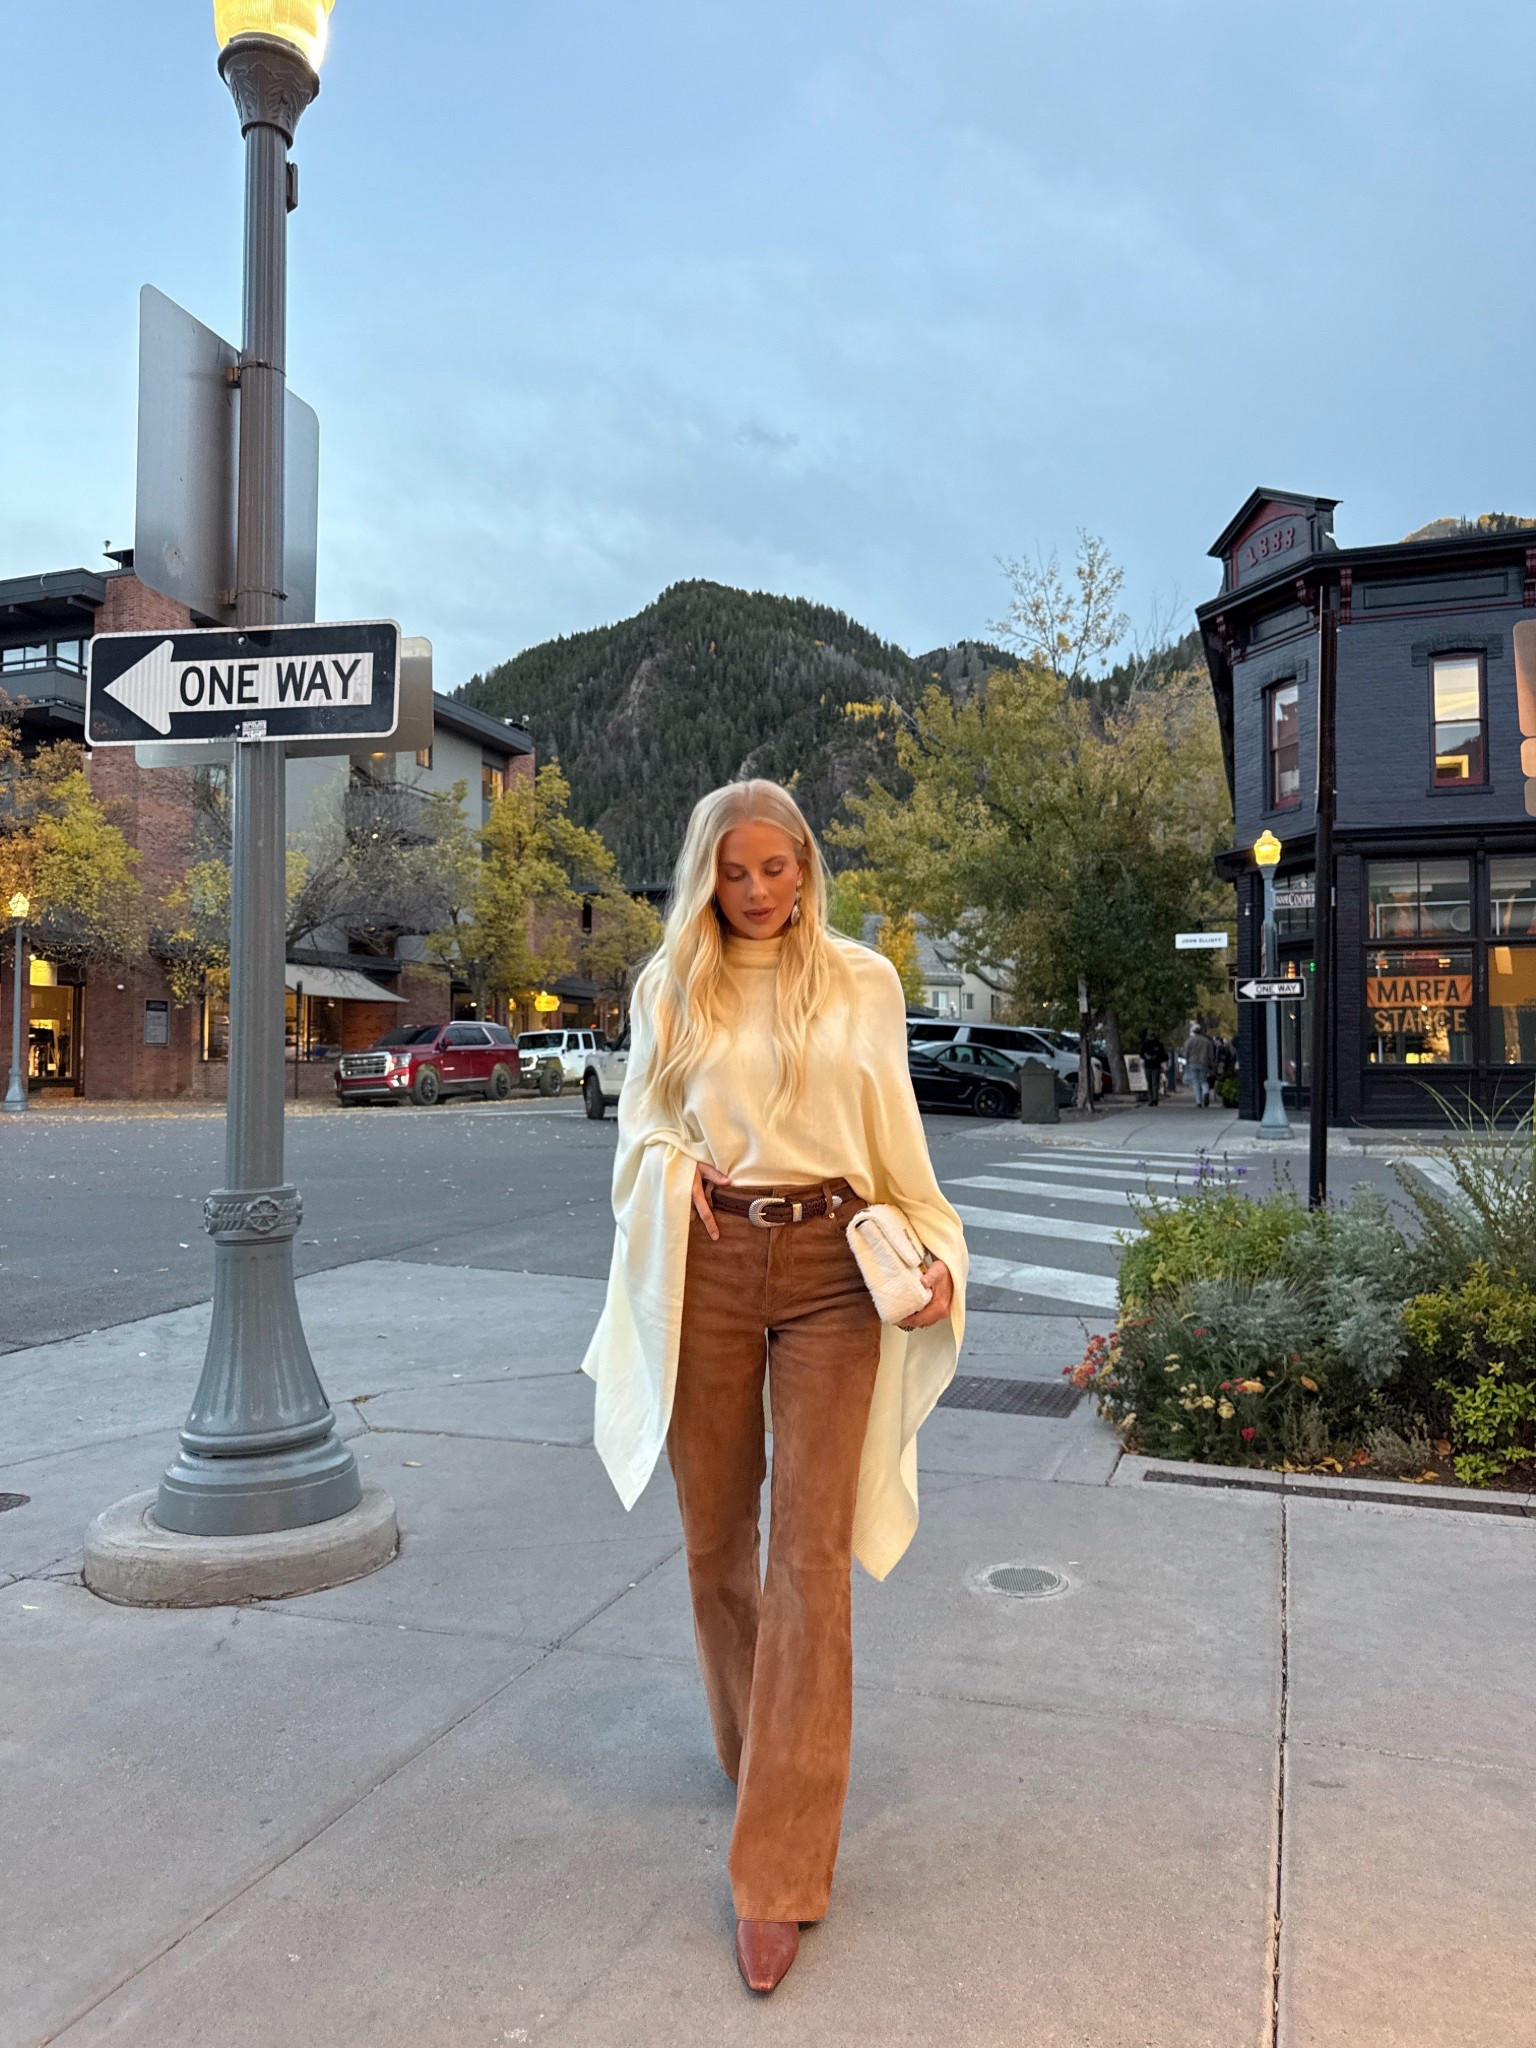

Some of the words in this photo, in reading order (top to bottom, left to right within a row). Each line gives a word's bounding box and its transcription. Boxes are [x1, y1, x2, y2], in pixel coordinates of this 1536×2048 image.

[1246, 526, 1295, 568] 1888
[179, 664, 260, 707] ONE
[276, 658, 362, 702] WAY
[1255, 984, 1275, 994] ONE
[1278, 983, 1297, 993] WAY
[1376, 979, 1460, 1003] MARFA
[1373, 1008, 1468, 1034] STANCE
